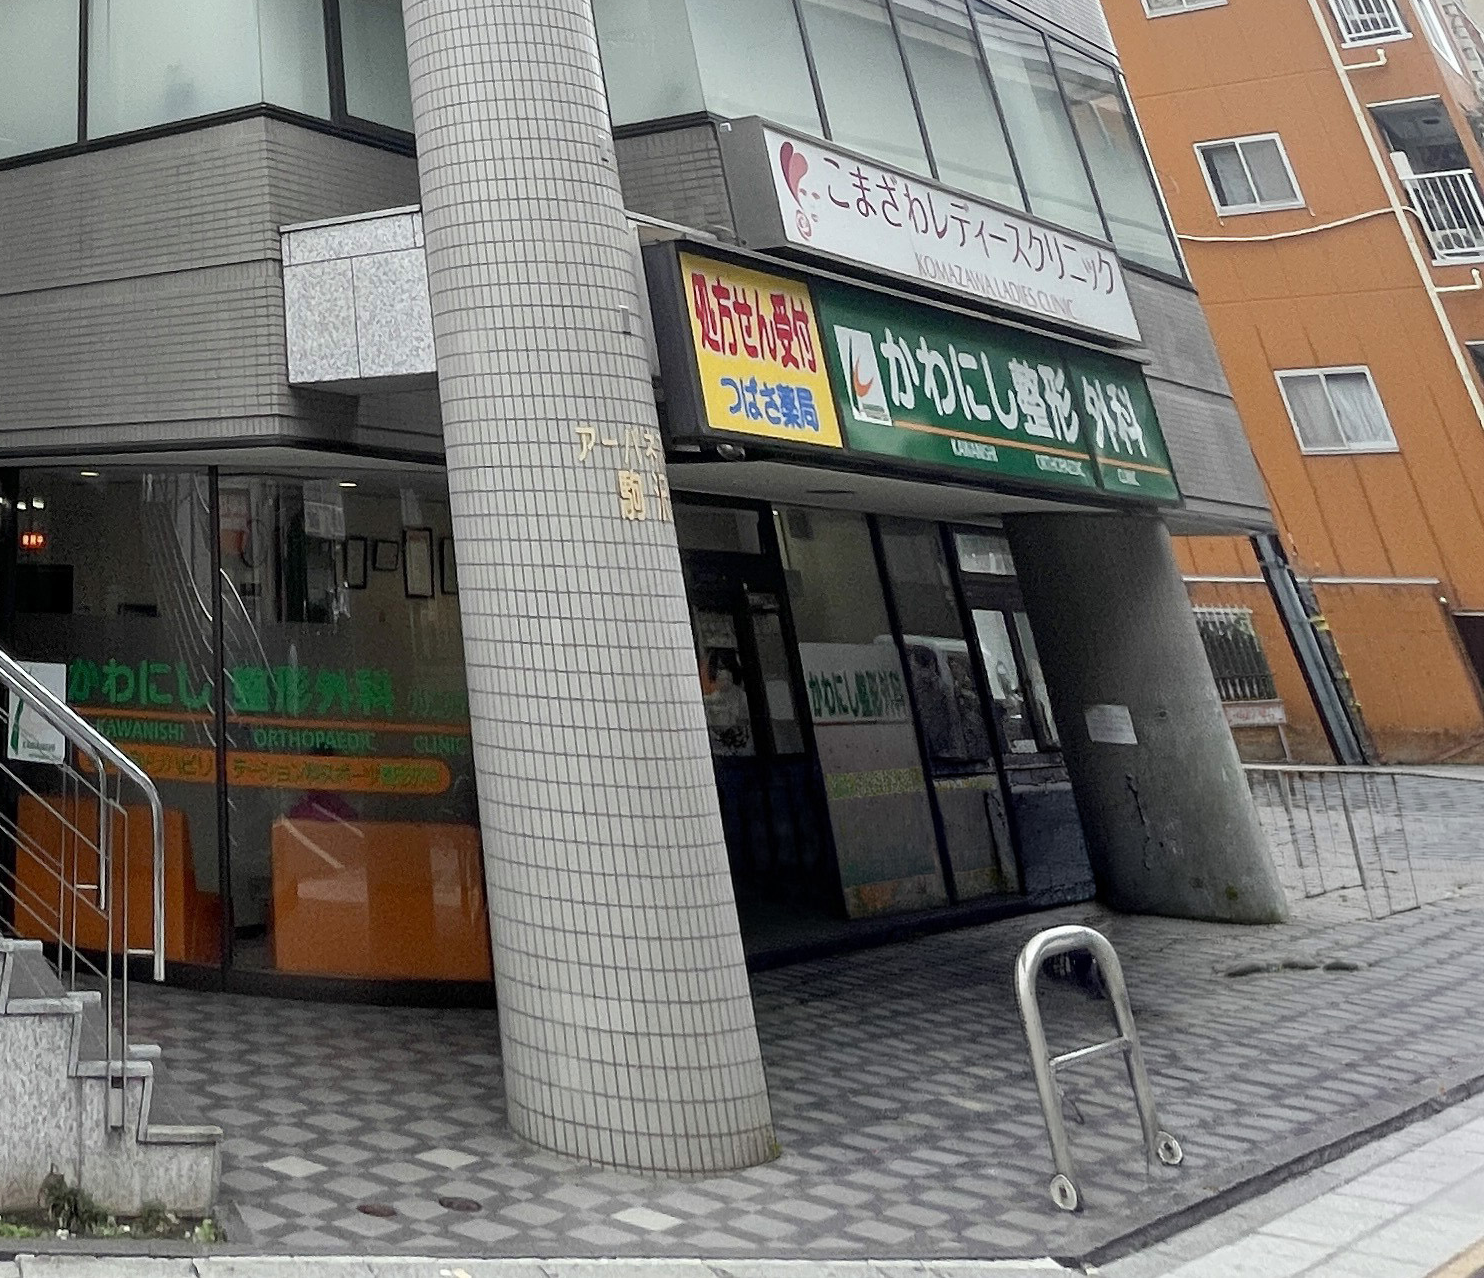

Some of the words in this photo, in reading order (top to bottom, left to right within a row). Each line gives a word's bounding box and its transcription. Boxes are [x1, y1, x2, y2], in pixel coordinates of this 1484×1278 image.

[823, 157, 1115, 294] こまざわレディースクリニック
[916, 252, 996, 297] KOMAZAWA
[691, 273, 817, 373] 処方せん受付
[720, 376, 820, 432] つばさ薬局
[880, 326, 1148, 458] かわにし整形外科
[68, 657, 394, 716] かわにし整形外科
[96, 718, 185, 743] KAWANISHI
[413, 735, 469, 756] CLINIC
